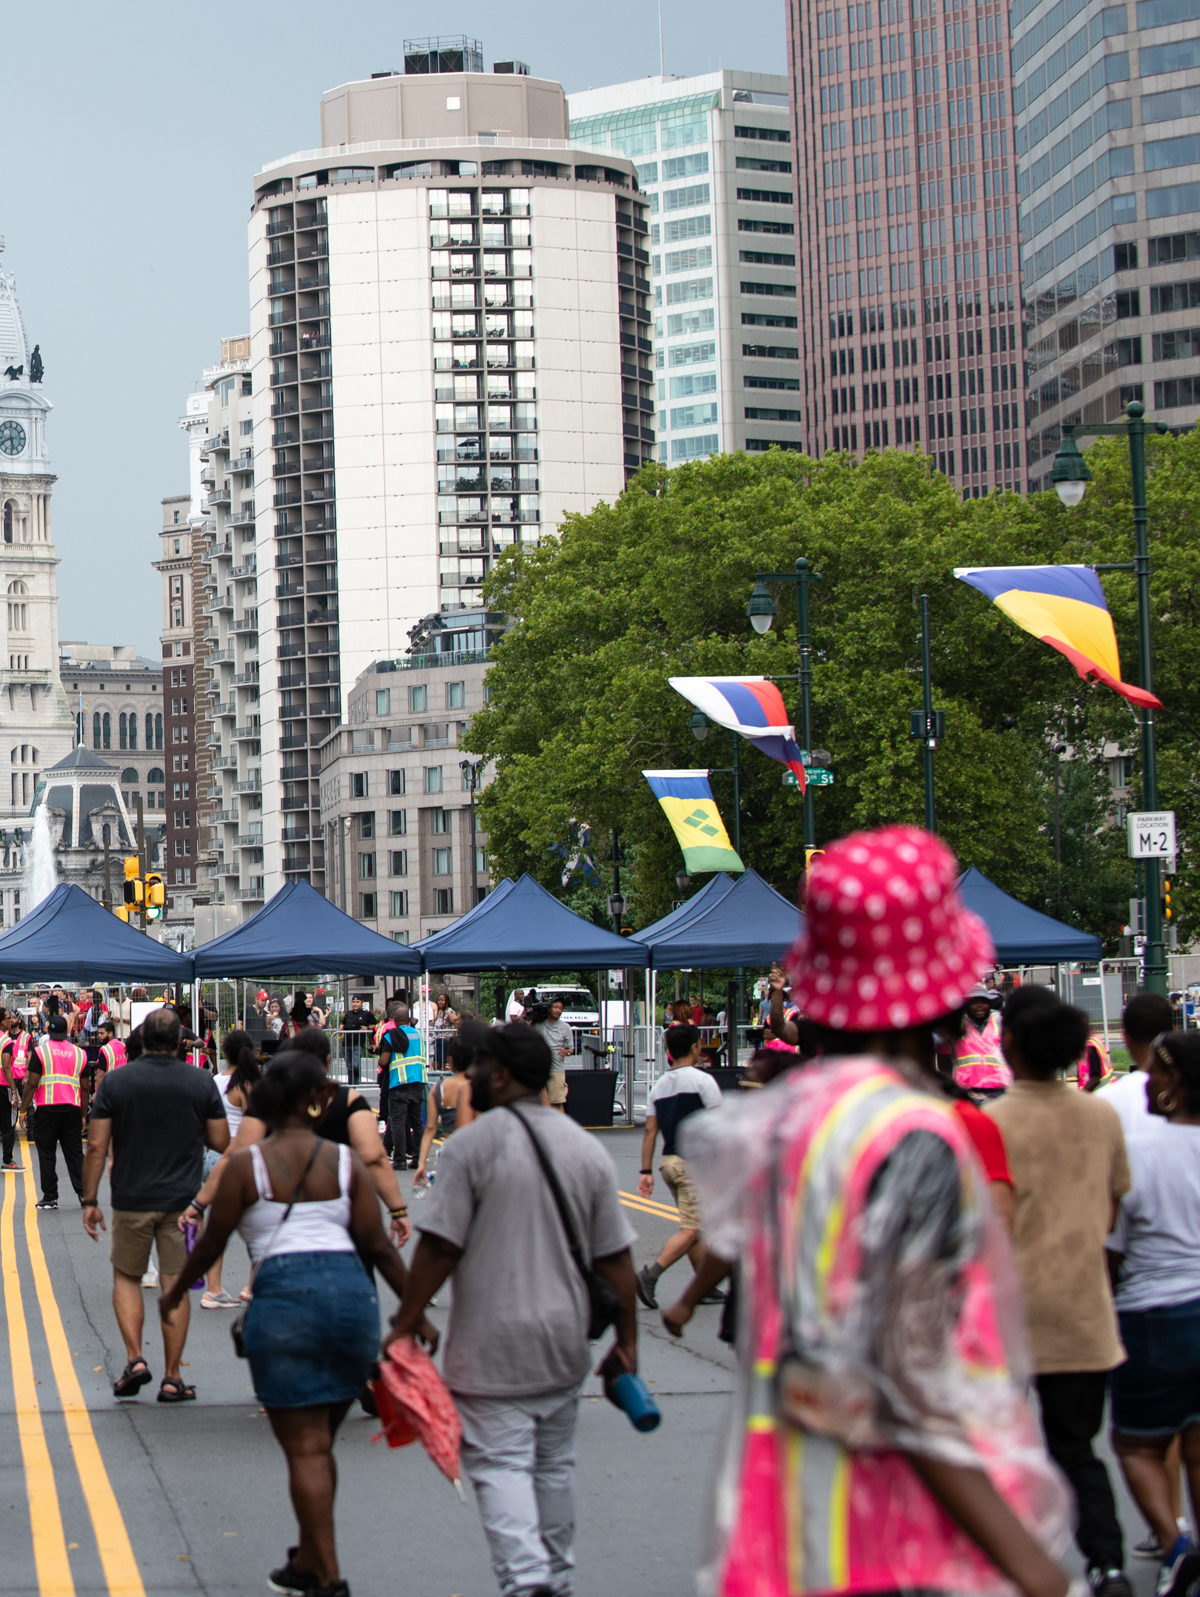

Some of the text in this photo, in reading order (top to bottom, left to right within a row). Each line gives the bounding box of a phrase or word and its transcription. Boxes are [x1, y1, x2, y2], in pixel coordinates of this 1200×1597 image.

[821, 774, 834, 784] St
[1139, 832, 1168, 852] M-2
[52, 1049, 73, 1059] STAFF
